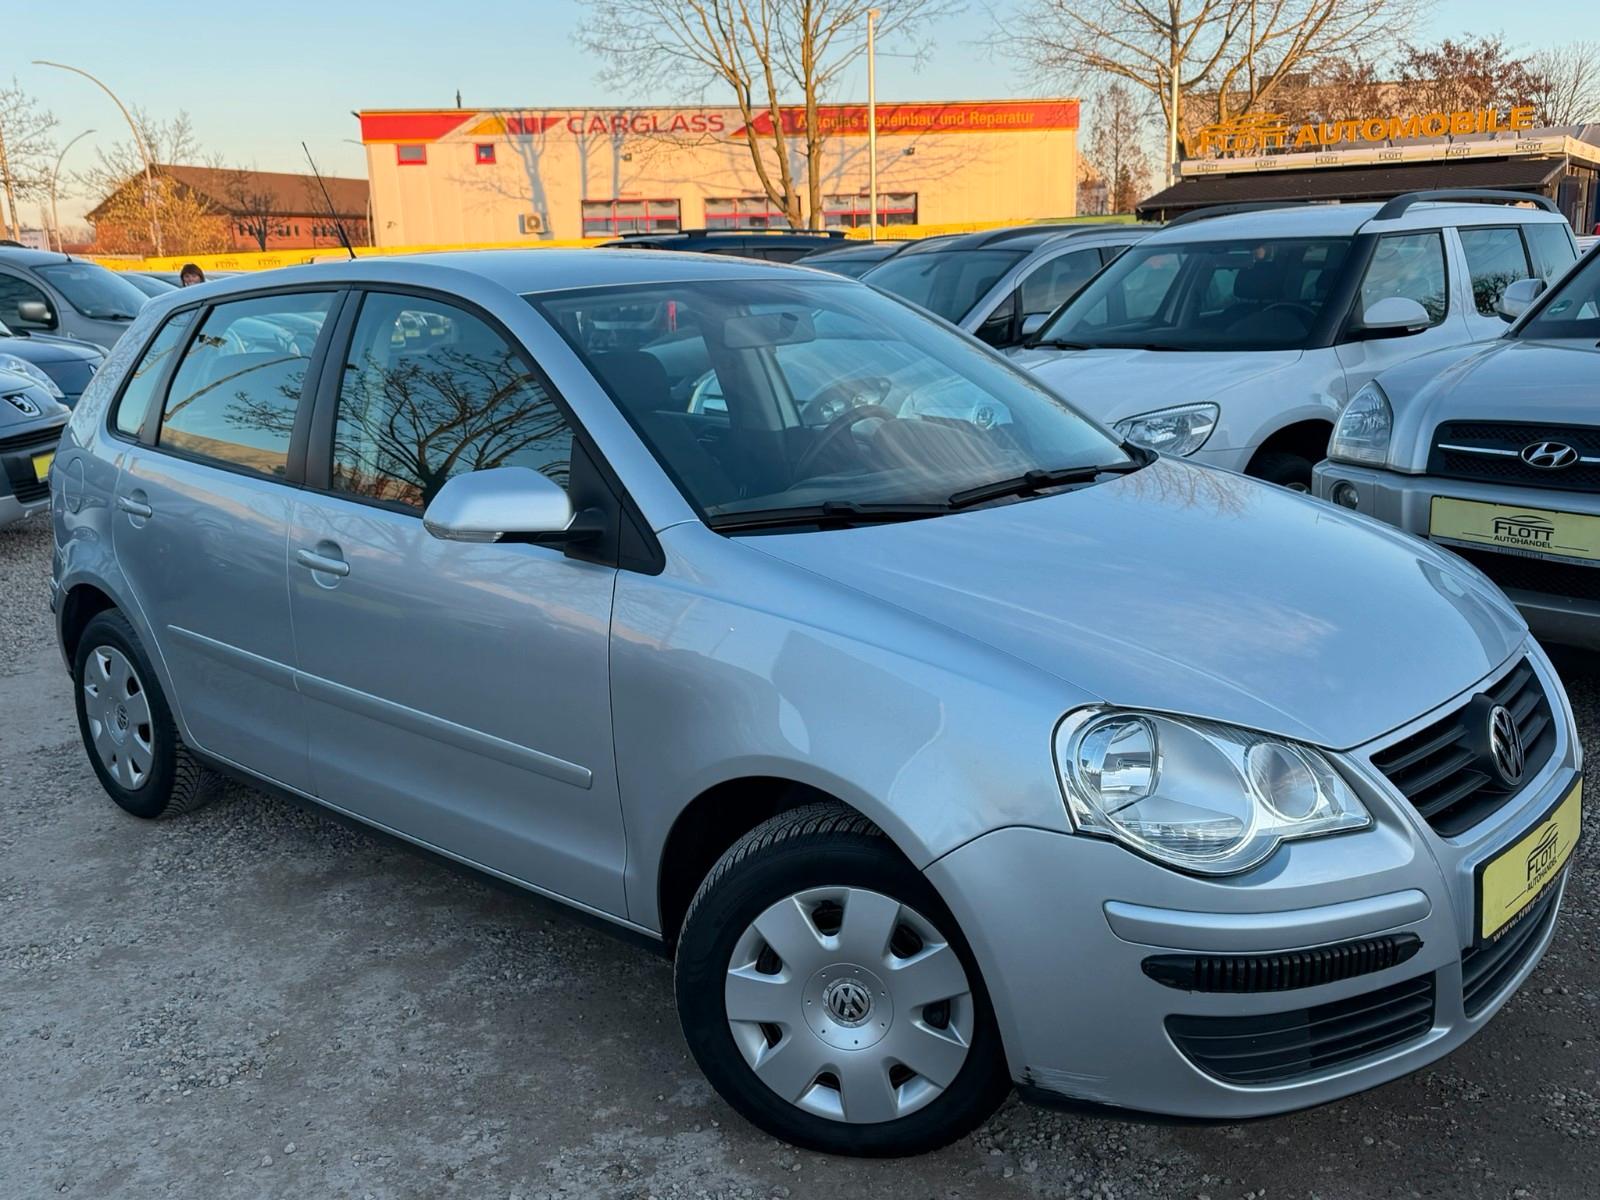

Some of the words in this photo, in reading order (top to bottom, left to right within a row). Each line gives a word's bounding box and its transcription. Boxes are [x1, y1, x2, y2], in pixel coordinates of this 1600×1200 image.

[566, 114, 726, 135] CARGLASS
[970, 111, 1035, 127] Reparatur
[1296, 106, 1534, 145] AUTOMOBILE
[1494, 520, 1555, 541] FLOTT
[1494, 534, 1553, 549] AUTOHANDEL
[1527, 833, 1559, 881] FLOTT
